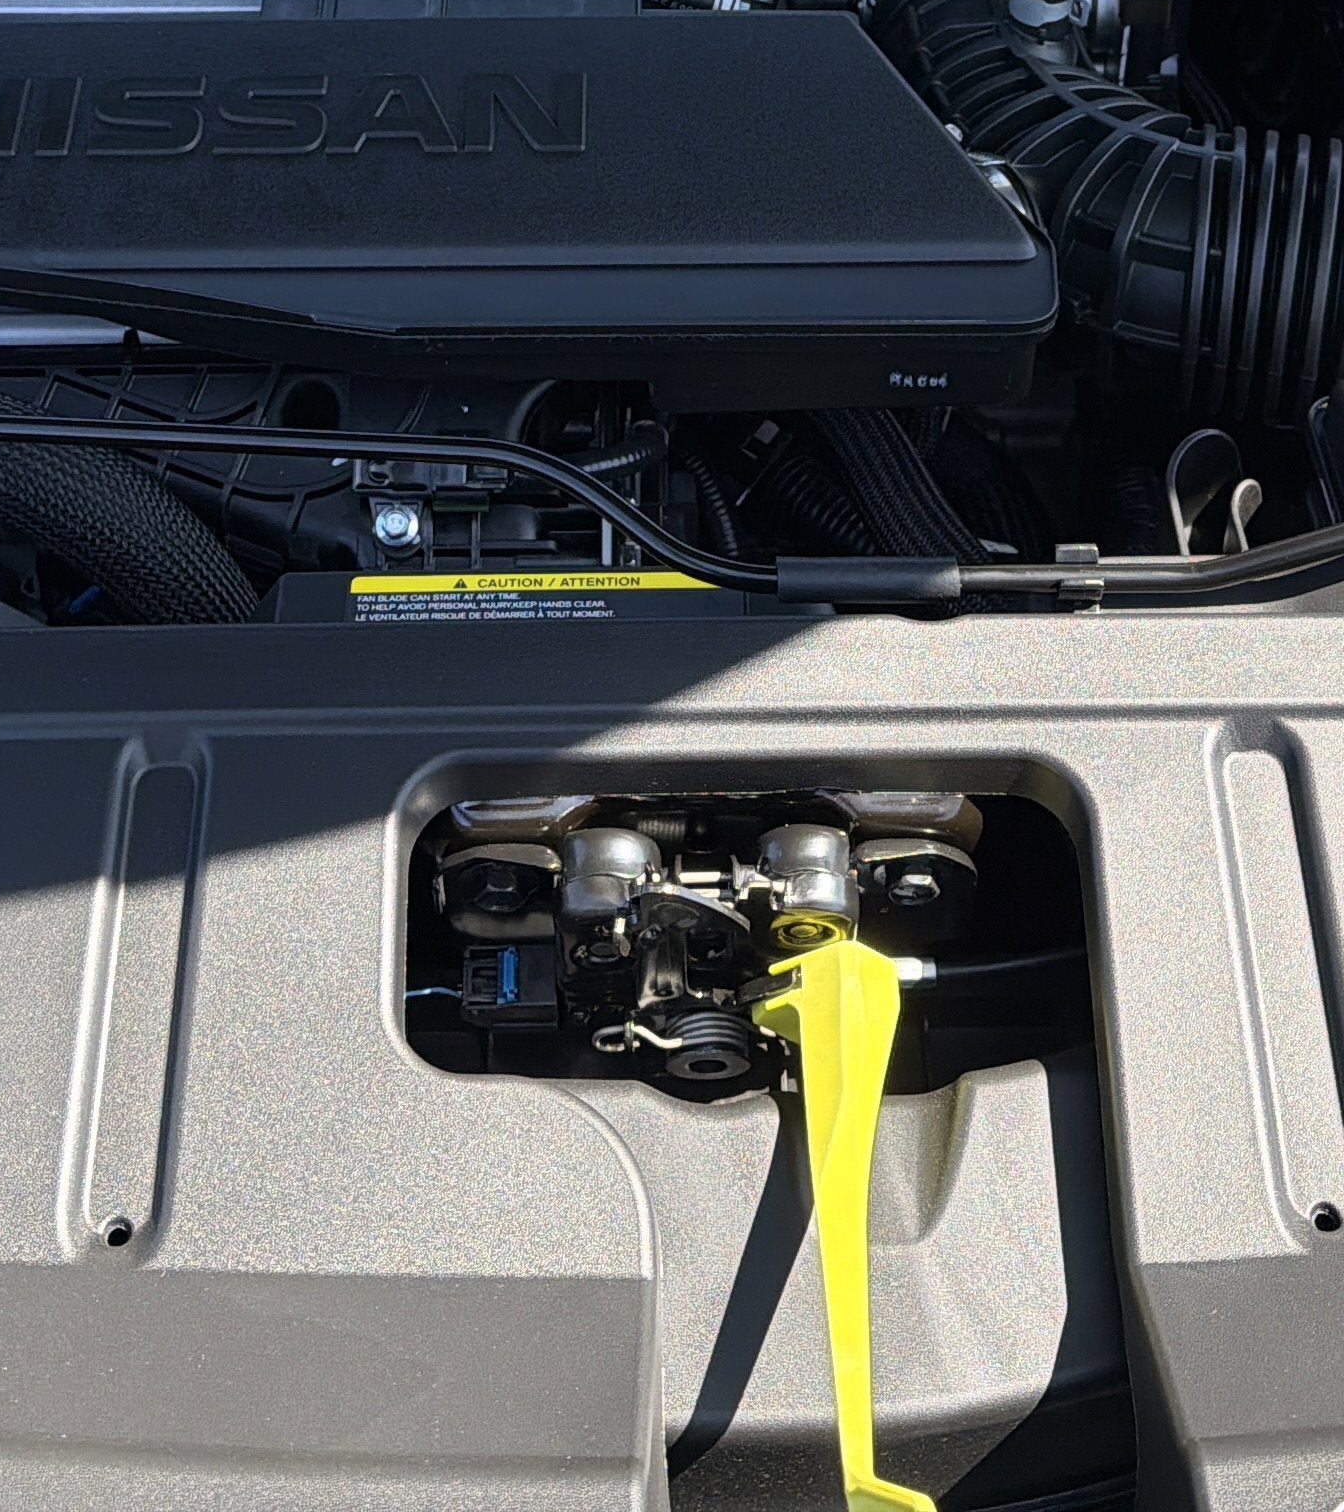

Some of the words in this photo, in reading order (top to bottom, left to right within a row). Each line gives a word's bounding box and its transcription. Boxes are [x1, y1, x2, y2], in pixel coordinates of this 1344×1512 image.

[477, 577, 543, 588] CAUTION
[548, 577, 556, 587] /
[560, 576, 641, 587] ATTENTION
[377, 594, 408, 602] BLADE
[432, 593, 461, 601] START
[371, 603, 396, 611] HELP
[428, 602, 478, 610] PERSONAL
[538, 600, 572, 608] HANDS
[355, 613, 367, 621] LE
[369, 613, 429, 621] VENTILATEUR
[431, 612, 467, 620] RISQUE
[484, 610, 535, 619] DÉMARRER
[537, 607, 544, 618] À
[546, 610, 570, 618] TOUT
